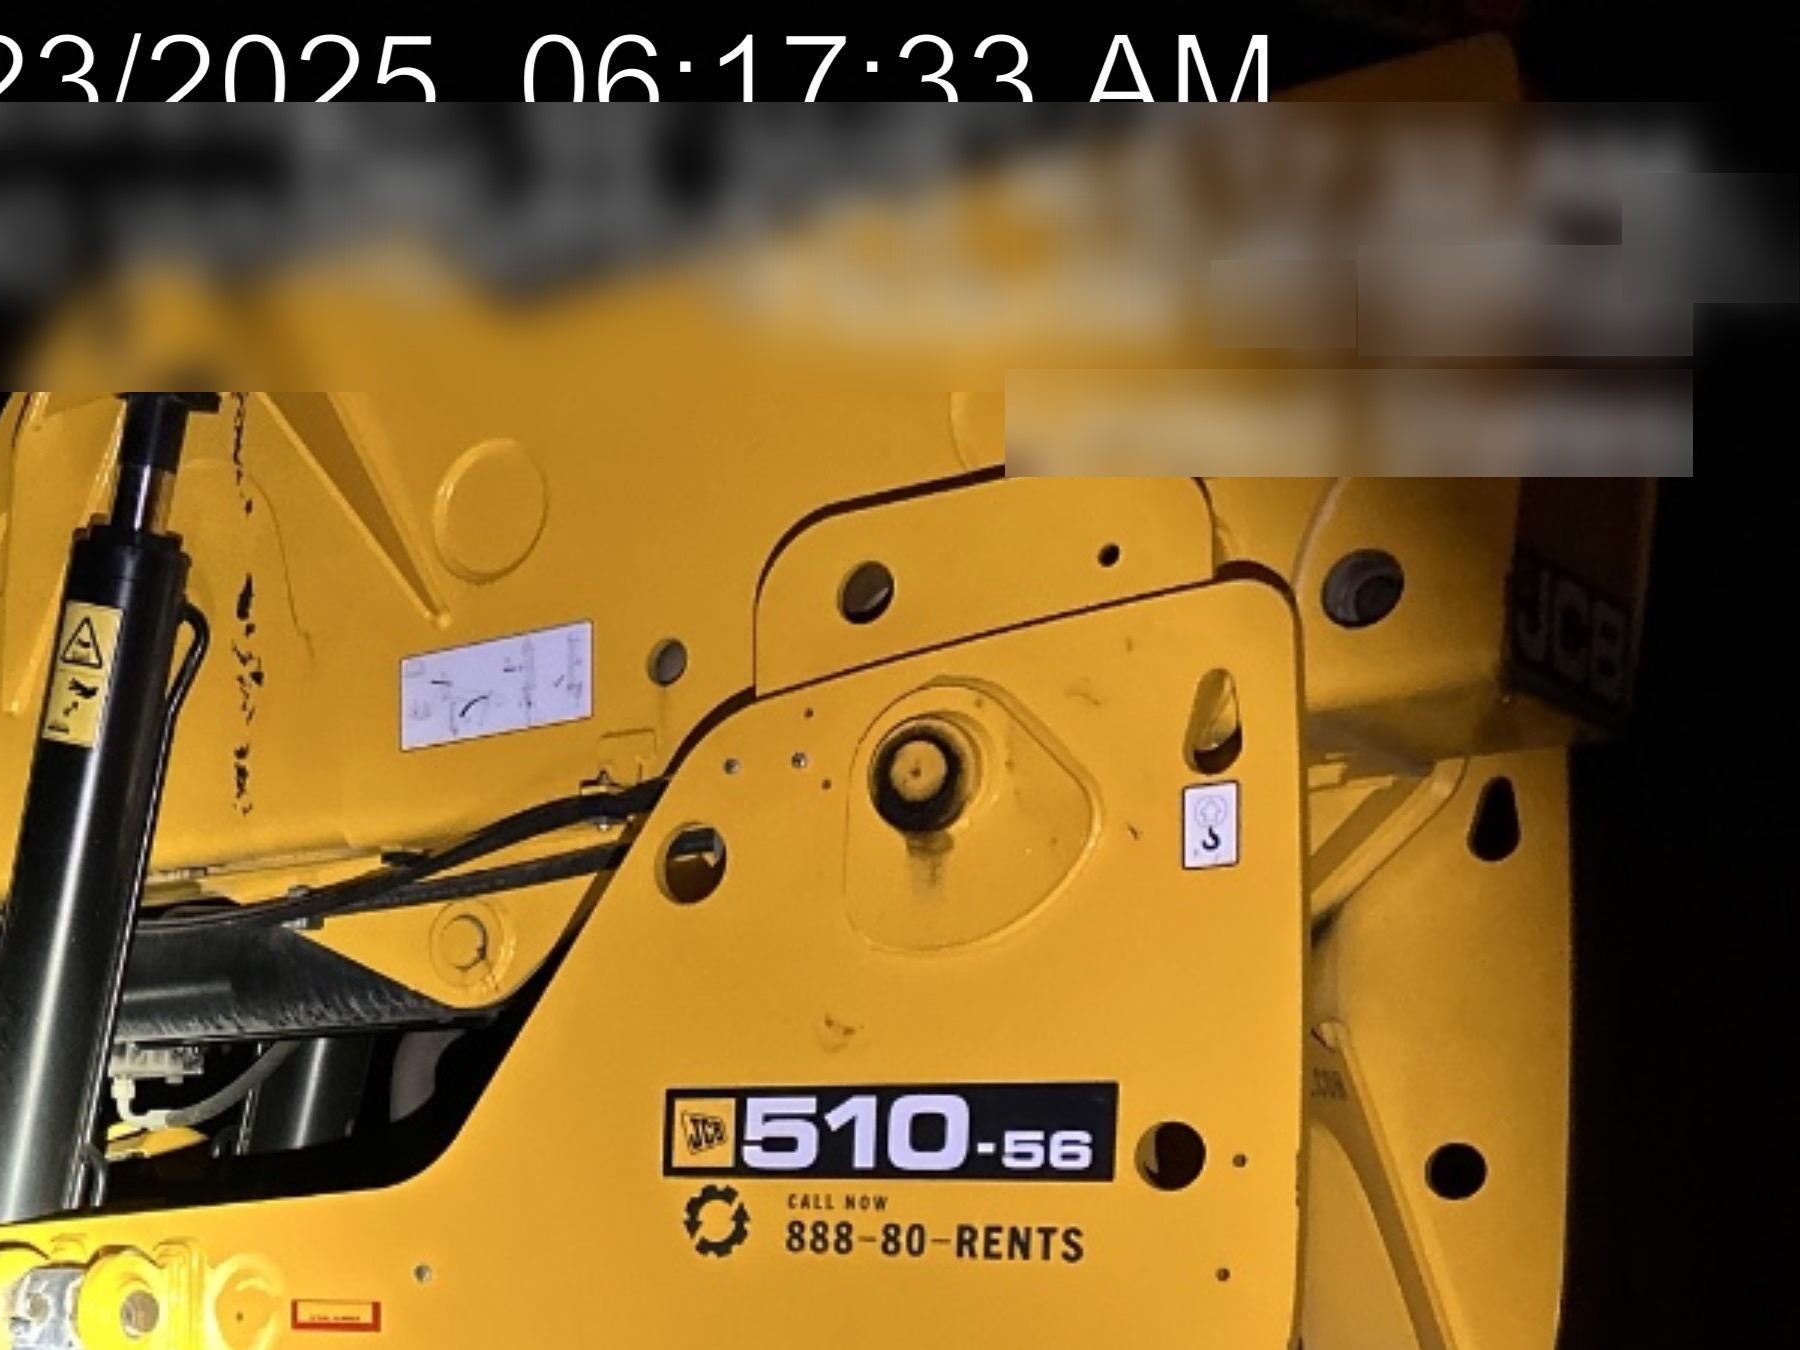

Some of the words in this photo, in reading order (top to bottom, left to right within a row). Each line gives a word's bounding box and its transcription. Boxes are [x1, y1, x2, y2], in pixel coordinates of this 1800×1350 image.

[787, 1192, 835, 1211] CALL
[845, 1193, 889, 1212] NOW
[785, 1219, 1085, 1264] 888-80-RENTS
